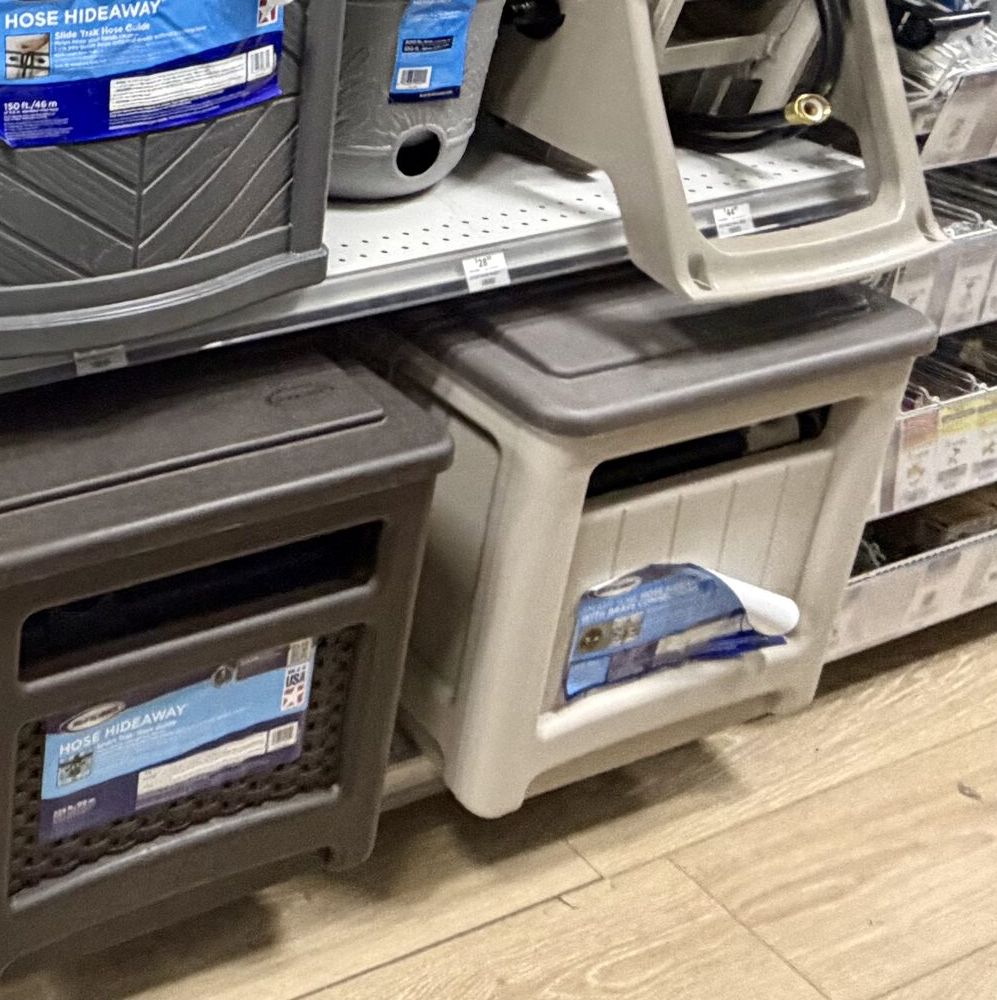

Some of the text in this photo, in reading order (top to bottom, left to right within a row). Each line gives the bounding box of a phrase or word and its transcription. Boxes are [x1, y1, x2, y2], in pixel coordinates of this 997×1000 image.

[5, 1, 162, 30] HOSE HIDEAWAY
[55, 31, 77, 40] Slide
[102, 25, 123, 35] Hose
[286, 672, 304, 687] USA
[59, 732, 100, 755] HOSE
[105, 704, 186, 738] HIDEAWAY
